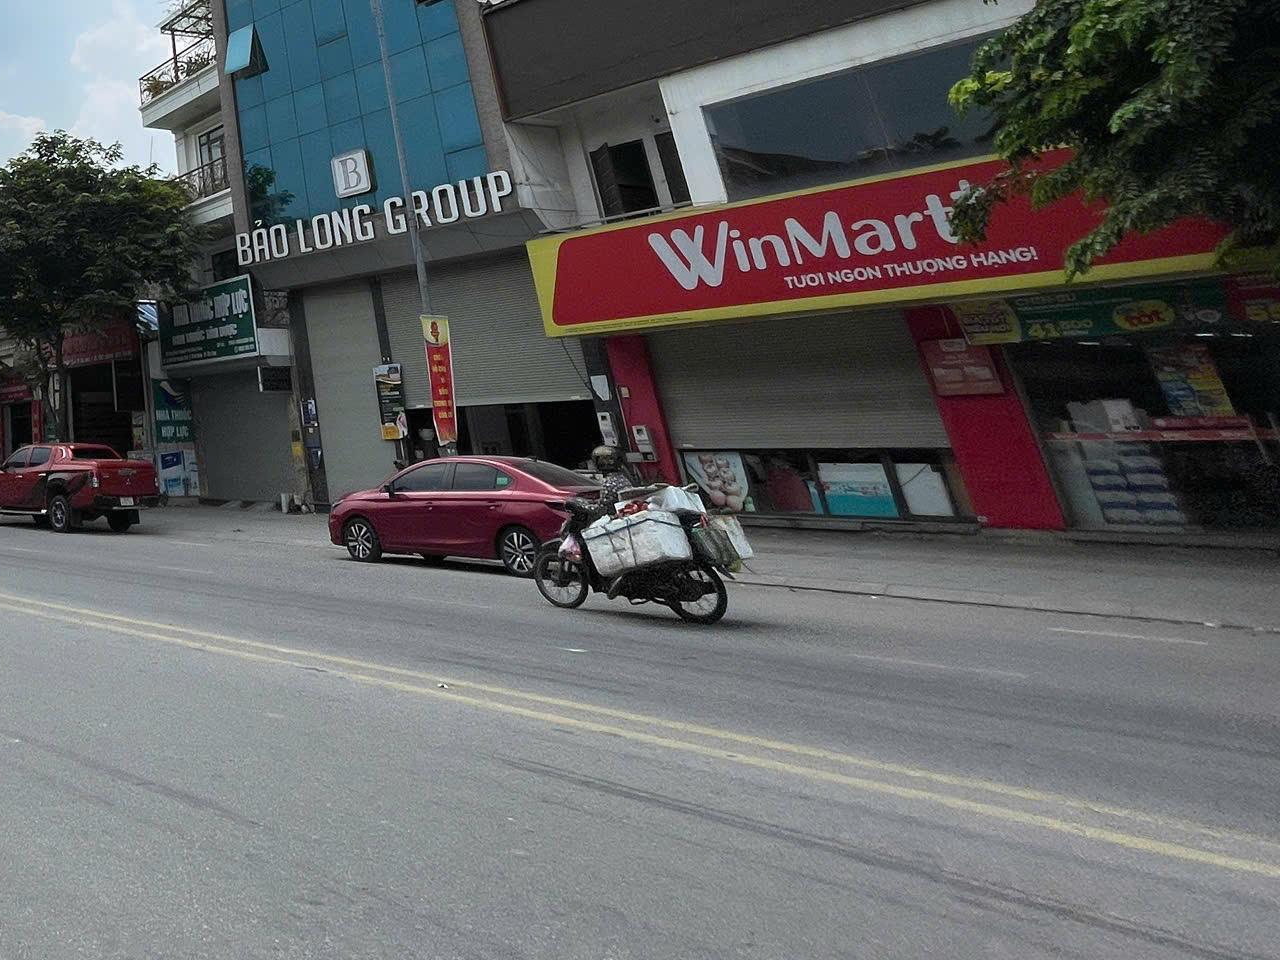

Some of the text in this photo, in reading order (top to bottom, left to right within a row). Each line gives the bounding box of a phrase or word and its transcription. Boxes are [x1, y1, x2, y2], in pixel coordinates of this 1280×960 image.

[338, 156, 362, 191] B
[235, 170, 513, 266] BẢO LONG GROUP
[828, 265, 882, 286] NGON
[883, 254, 968, 277] THƯỢNG
[970, 246, 1039, 269] HẠNG!
